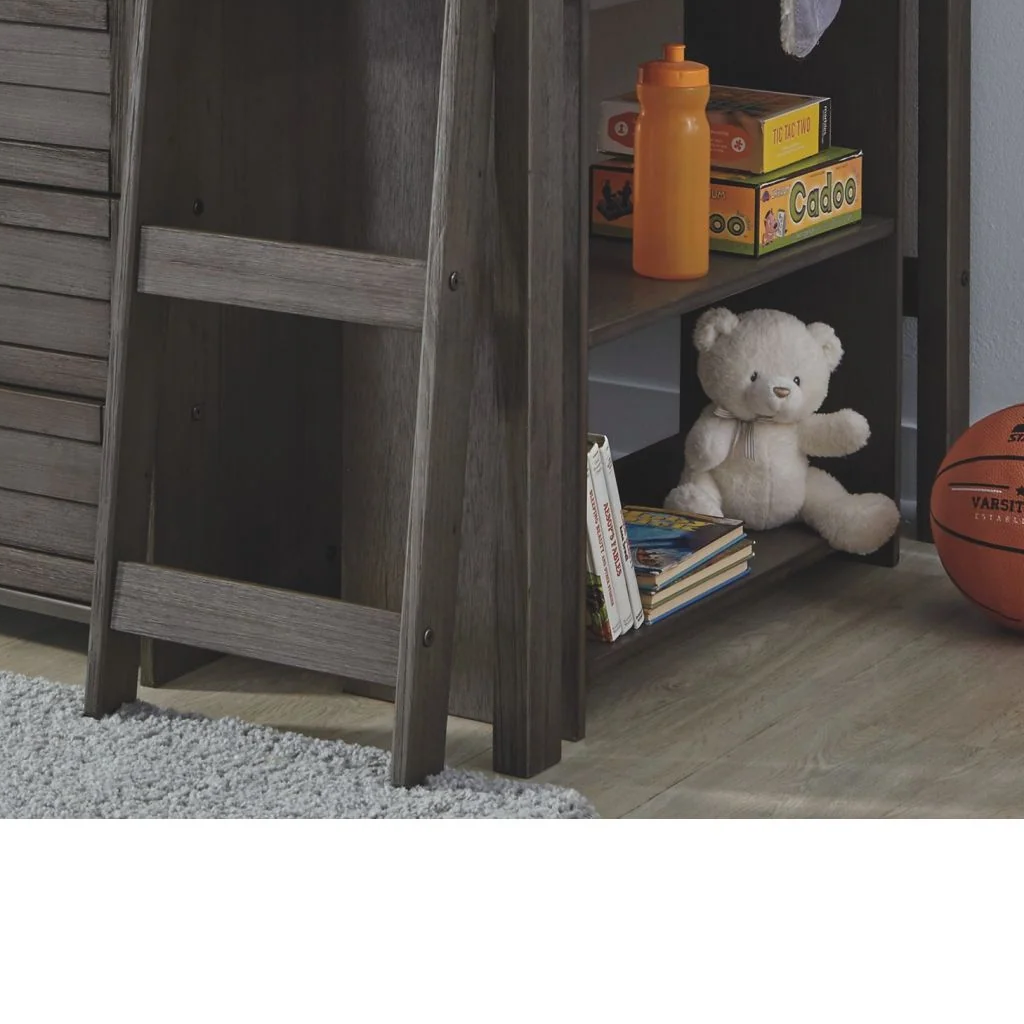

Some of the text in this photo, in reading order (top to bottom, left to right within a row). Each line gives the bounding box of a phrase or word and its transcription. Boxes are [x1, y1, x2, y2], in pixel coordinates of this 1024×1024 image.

[772, 127, 783, 145] TIC
[784, 123, 795, 142] TAC
[796, 117, 811, 137] TWO
[789, 171, 857, 224] Cadoo
